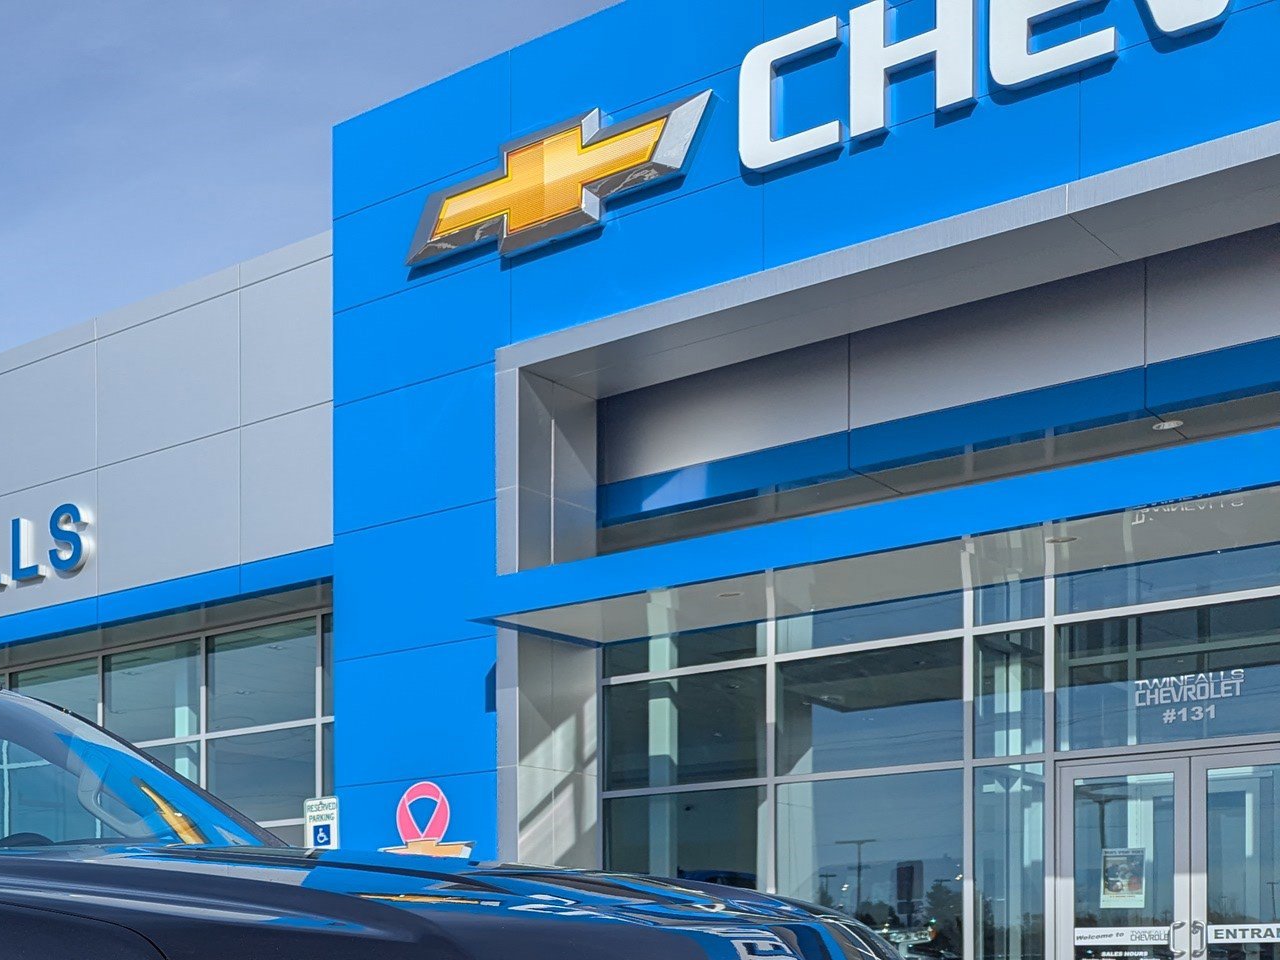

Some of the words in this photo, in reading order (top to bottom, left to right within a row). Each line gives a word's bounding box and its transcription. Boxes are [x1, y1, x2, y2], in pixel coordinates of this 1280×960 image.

[738, 0, 1233, 172] CHE
[1134, 669, 1245, 690] TWINFALLS
[1134, 679, 1245, 707] CHEVROLET
[1162, 704, 1217, 724] #131
[307, 802, 337, 813] RESERVED
[308, 812, 335, 823] PARKING
[1076, 932, 1114, 941] Welcome
